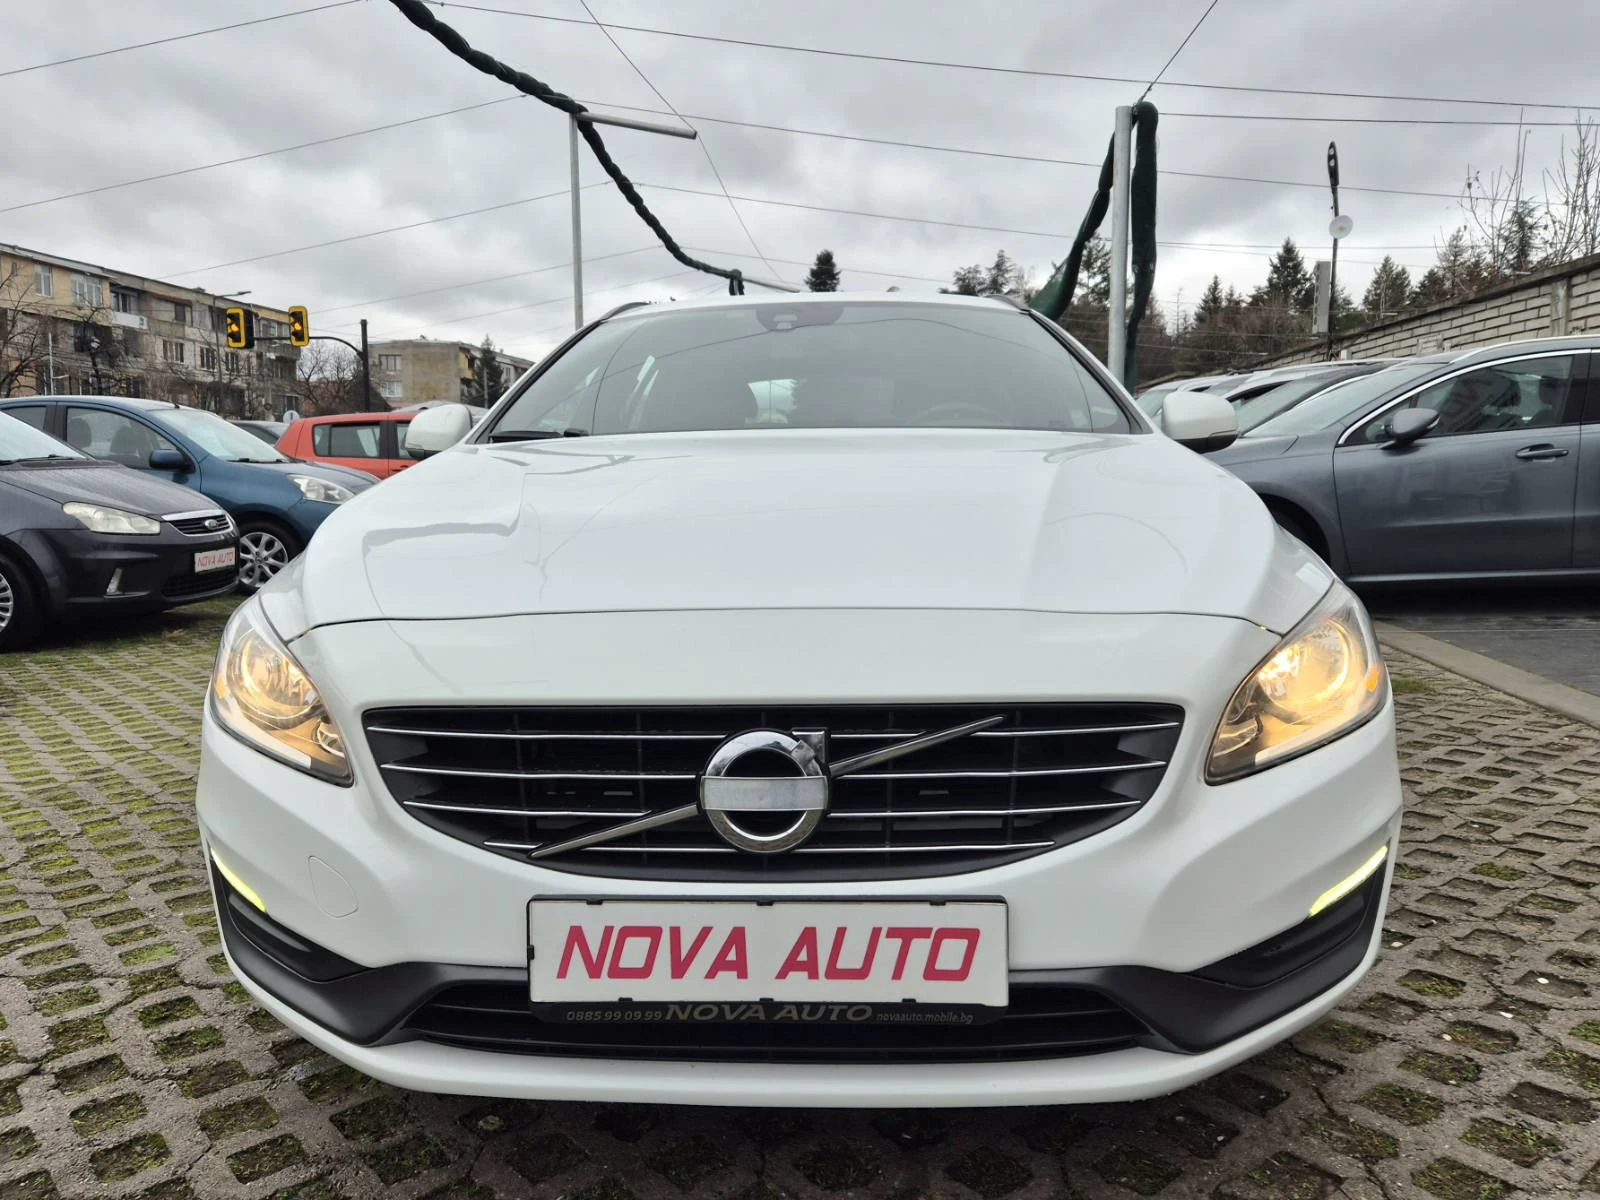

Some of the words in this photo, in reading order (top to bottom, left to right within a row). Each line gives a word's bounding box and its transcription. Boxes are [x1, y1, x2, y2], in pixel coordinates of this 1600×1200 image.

[556, 925, 749, 980] NOVA
[775, 927, 981, 982] AUTO
[566, 1011, 601, 1021] 0885
[604, 1011, 622, 1021] 99
[624, 1011, 642, 1021] 09
[644, 1011, 662, 1021] 99
[665, 1004, 766, 1021] NOVA
[773, 1004, 873, 1022] AUTO
